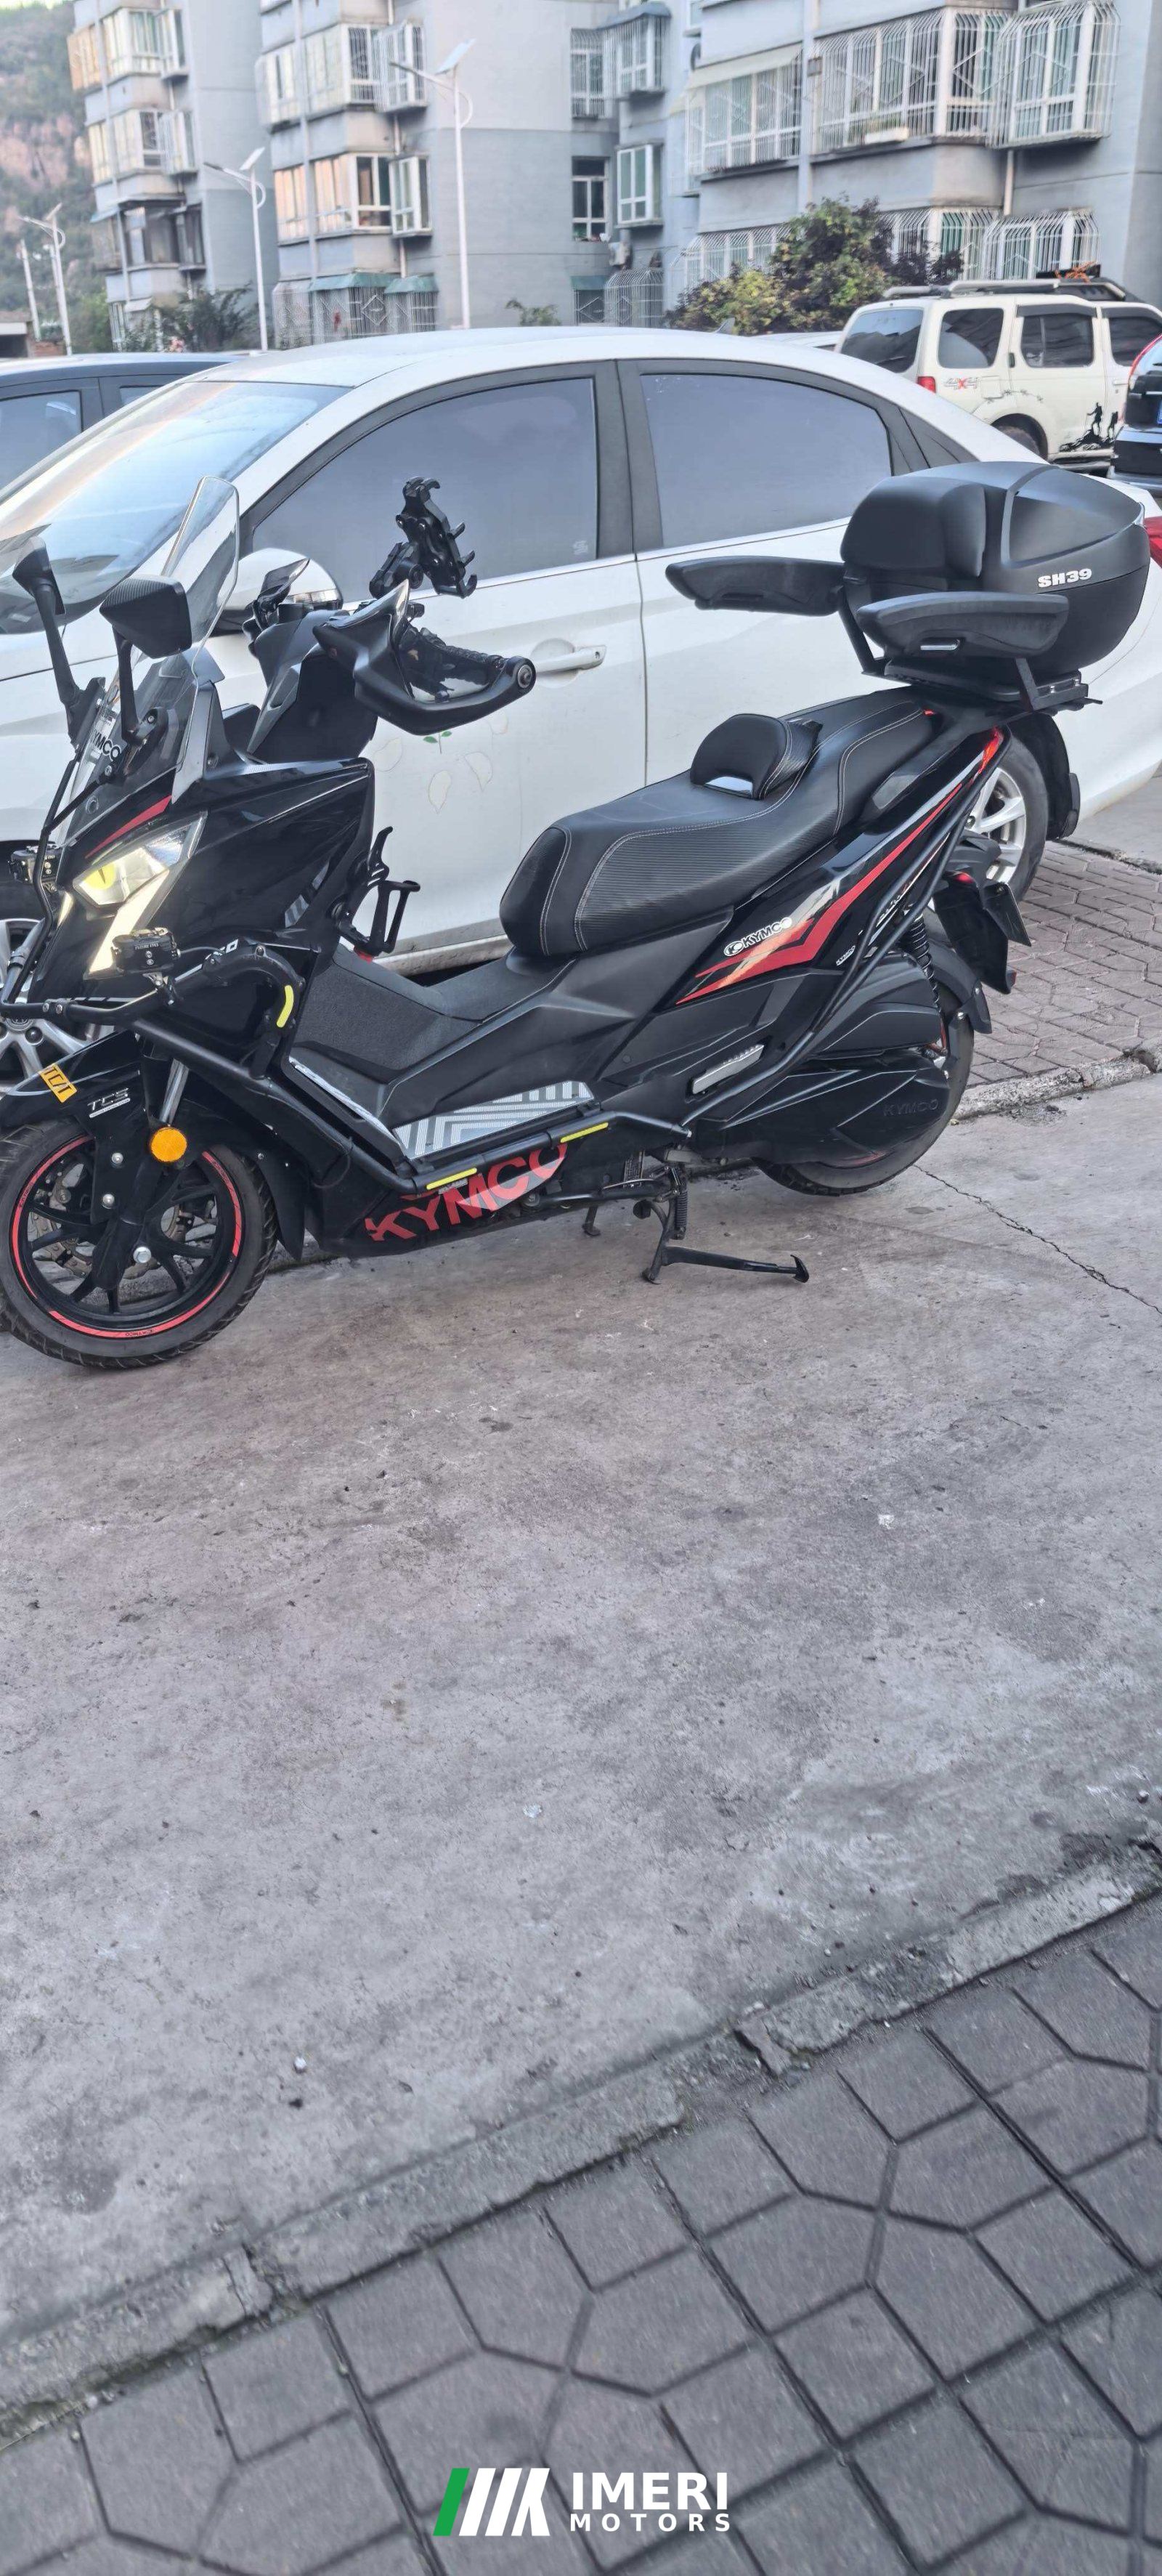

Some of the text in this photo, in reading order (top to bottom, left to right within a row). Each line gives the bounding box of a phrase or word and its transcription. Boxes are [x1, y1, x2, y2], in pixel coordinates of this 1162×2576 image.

[1038, 568, 1092, 588] SH39
[741, 917, 792, 948] KYMCO
[87, 1087, 129, 1111] TCS
